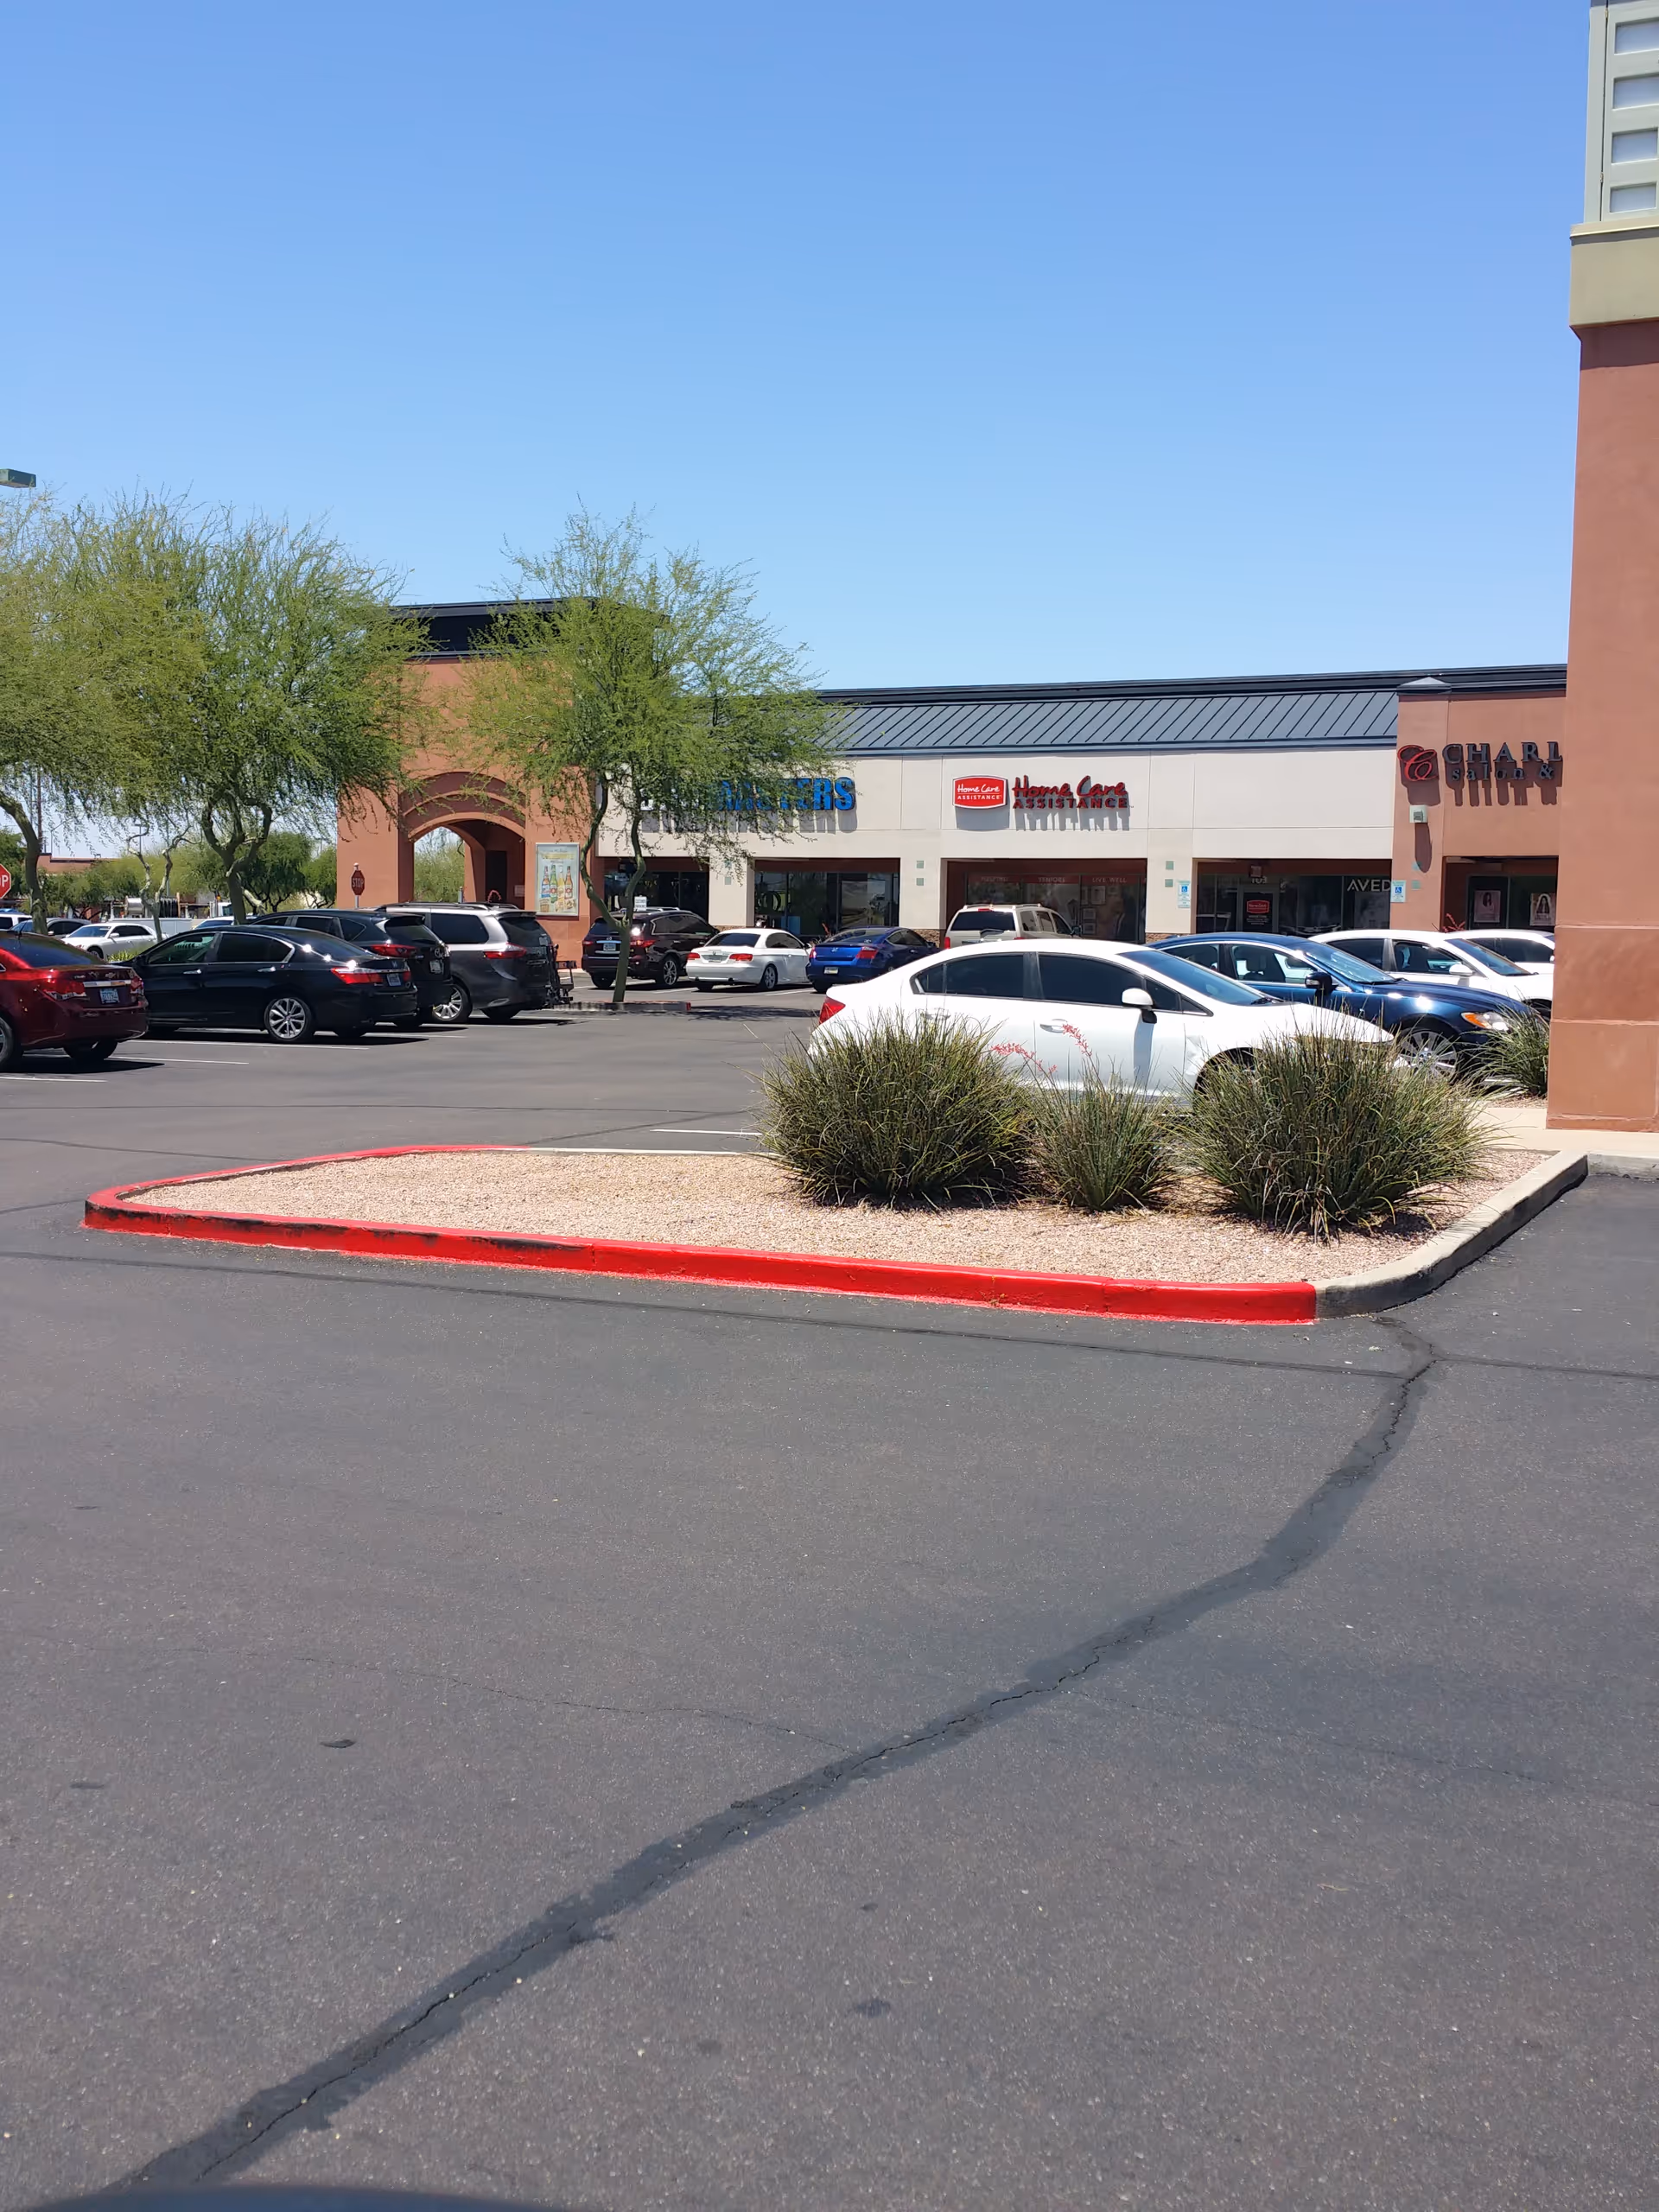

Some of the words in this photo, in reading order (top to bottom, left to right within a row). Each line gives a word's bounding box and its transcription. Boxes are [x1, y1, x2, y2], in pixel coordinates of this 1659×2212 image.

[1452, 764, 1524, 781] salon
[1539, 764, 1554, 779] &
[957, 784, 980, 793] Home
[981, 784, 1000, 793] Care
[1012, 774, 1074, 798] Home
[1077, 775, 1128, 798] Care
[1013, 798, 1128, 809] ASSISTANCE
[353, 877, 364, 888] STOP
